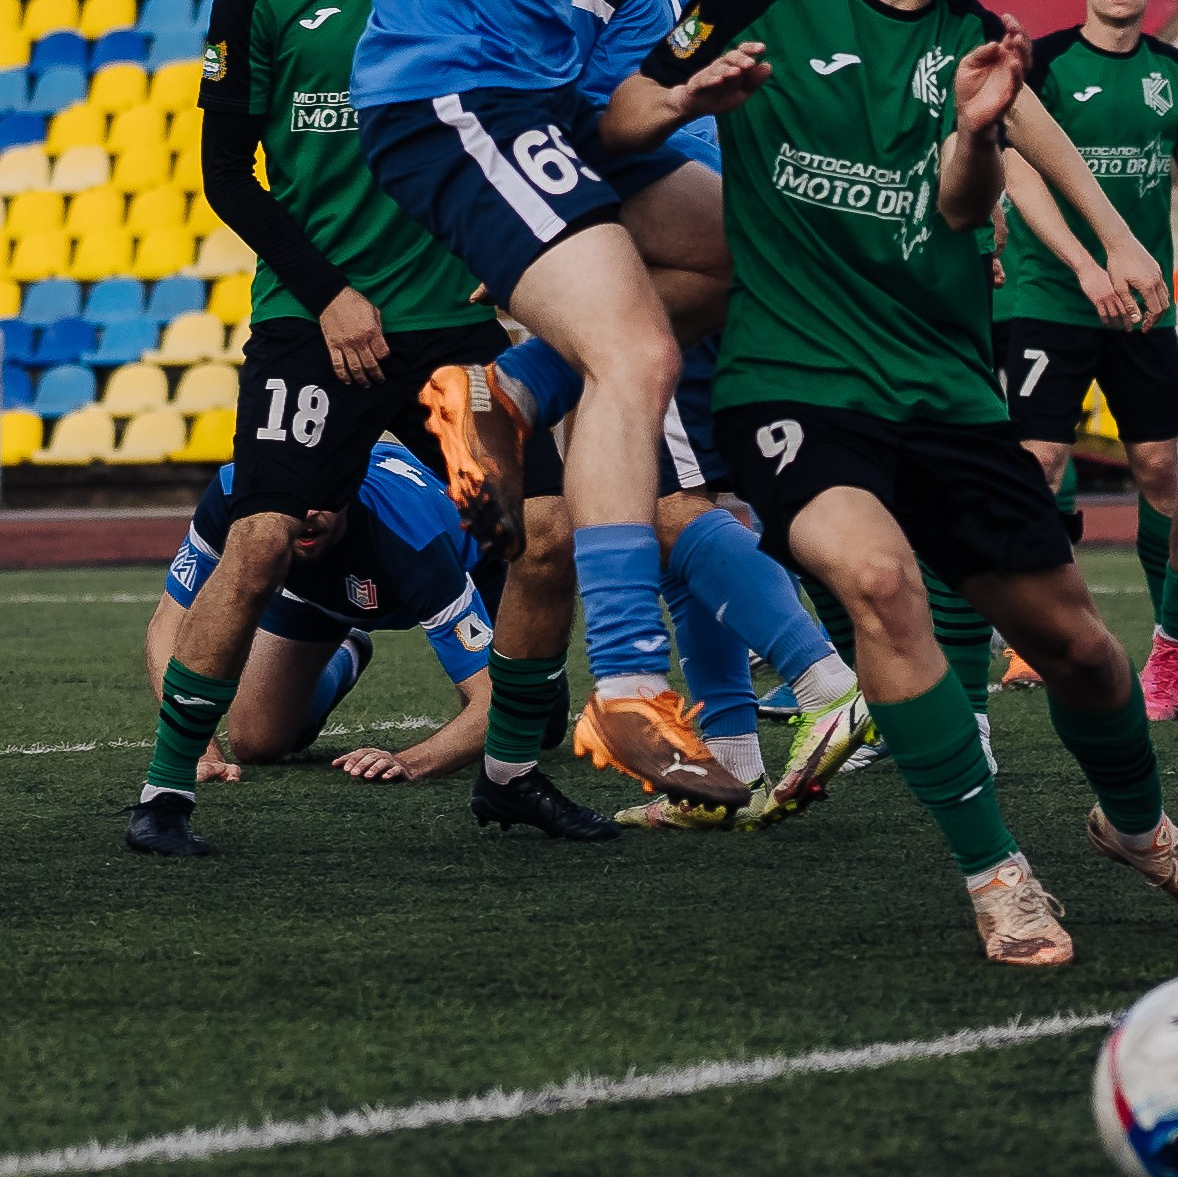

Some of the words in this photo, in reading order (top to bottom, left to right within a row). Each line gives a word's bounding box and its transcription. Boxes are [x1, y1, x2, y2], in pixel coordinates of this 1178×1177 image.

[1077, 147, 1140, 156] ОТОСАЛОН
[1087, 159, 1122, 173] OTO
[778, 165, 872, 208] MOTO
[876, 181, 931, 225] DRI
[1020, 348, 1049, 396] 7
[257, 378, 329, 447] 18
[756, 419, 804, 475] 9
